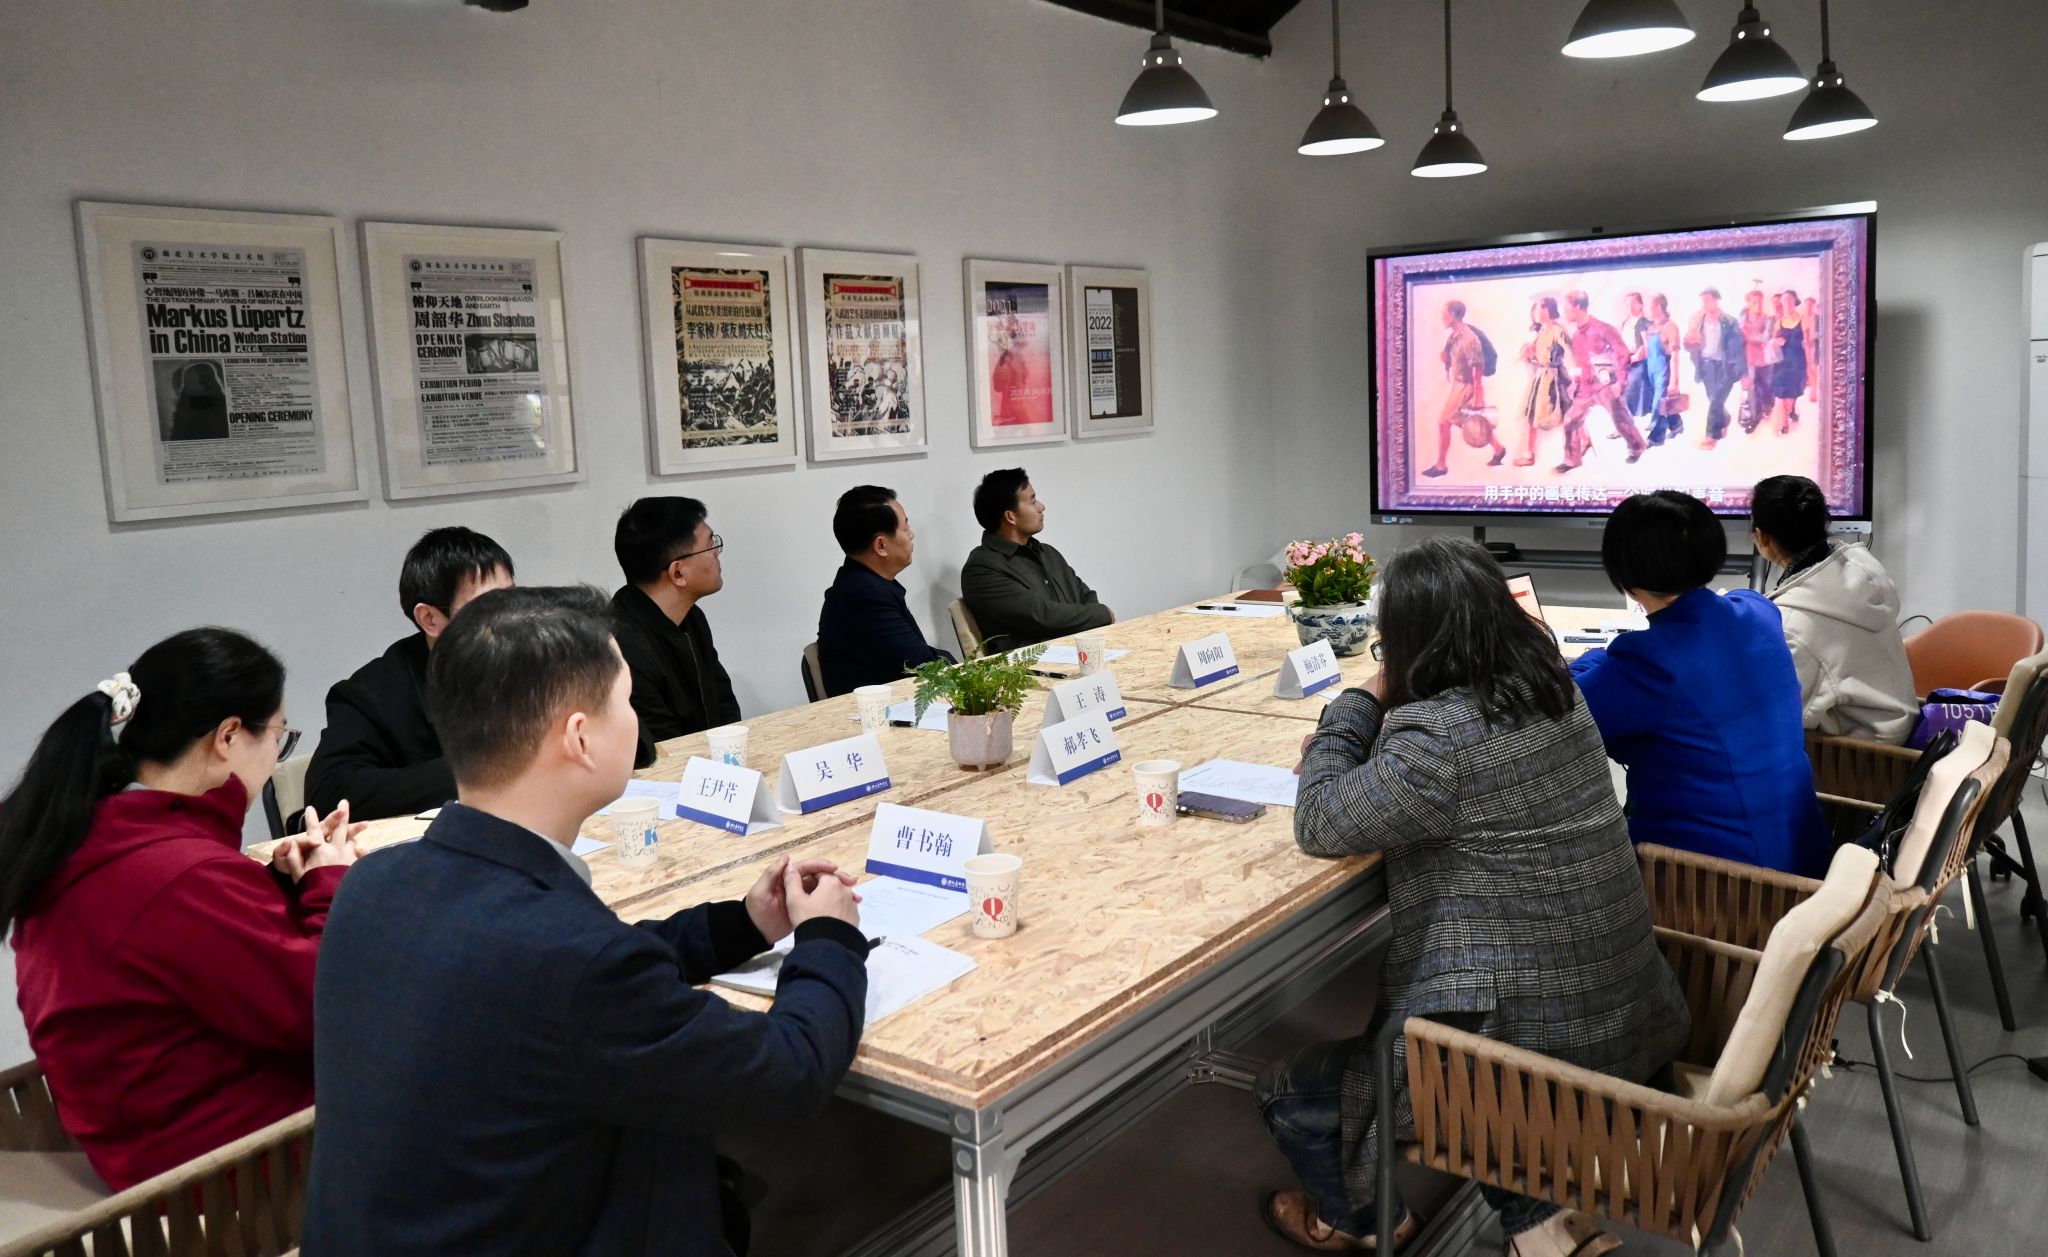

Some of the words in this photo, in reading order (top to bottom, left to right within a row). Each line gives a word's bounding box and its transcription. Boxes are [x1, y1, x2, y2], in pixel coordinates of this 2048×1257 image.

[162, 297, 220, 305] EXTRAORDINARY
[413, 295, 463, 309] 俯仰天地
[464, 295, 509, 303] OVERLOOKING
[986, 299, 1012, 314] 2021
[146, 303, 229, 328] Markus
[230, 305, 306, 331] Lüpertz
[415, 311, 464, 329] 周韶华
[466, 313, 491, 328] Zhou
[493, 313, 535, 328] Shaohua
[1089, 316, 1112, 331] 2022
[149, 329, 170, 354] in
[174, 329, 231, 354] China
[234, 332, 269, 344] Wuhan
[271, 332, 307, 344] Station
[416, 333, 463, 346] OPENING
[417, 346, 463, 358] CEREMONY
[420, 379, 458, 389] EXHIBITION
[459, 378, 482, 387] PERIOD
[421, 392, 461, 402] EXHIBITION
[461, 391, 482, 401] VENUE
[229, 411, 268, 424] OPENING
[268, 409, 313, 422] CEREMONY
[1197, 645, 1223, 665] 周向阳
[697, 776, 739, 804] 王尹芹
[897, 825, 953, 857] 曹书翰
